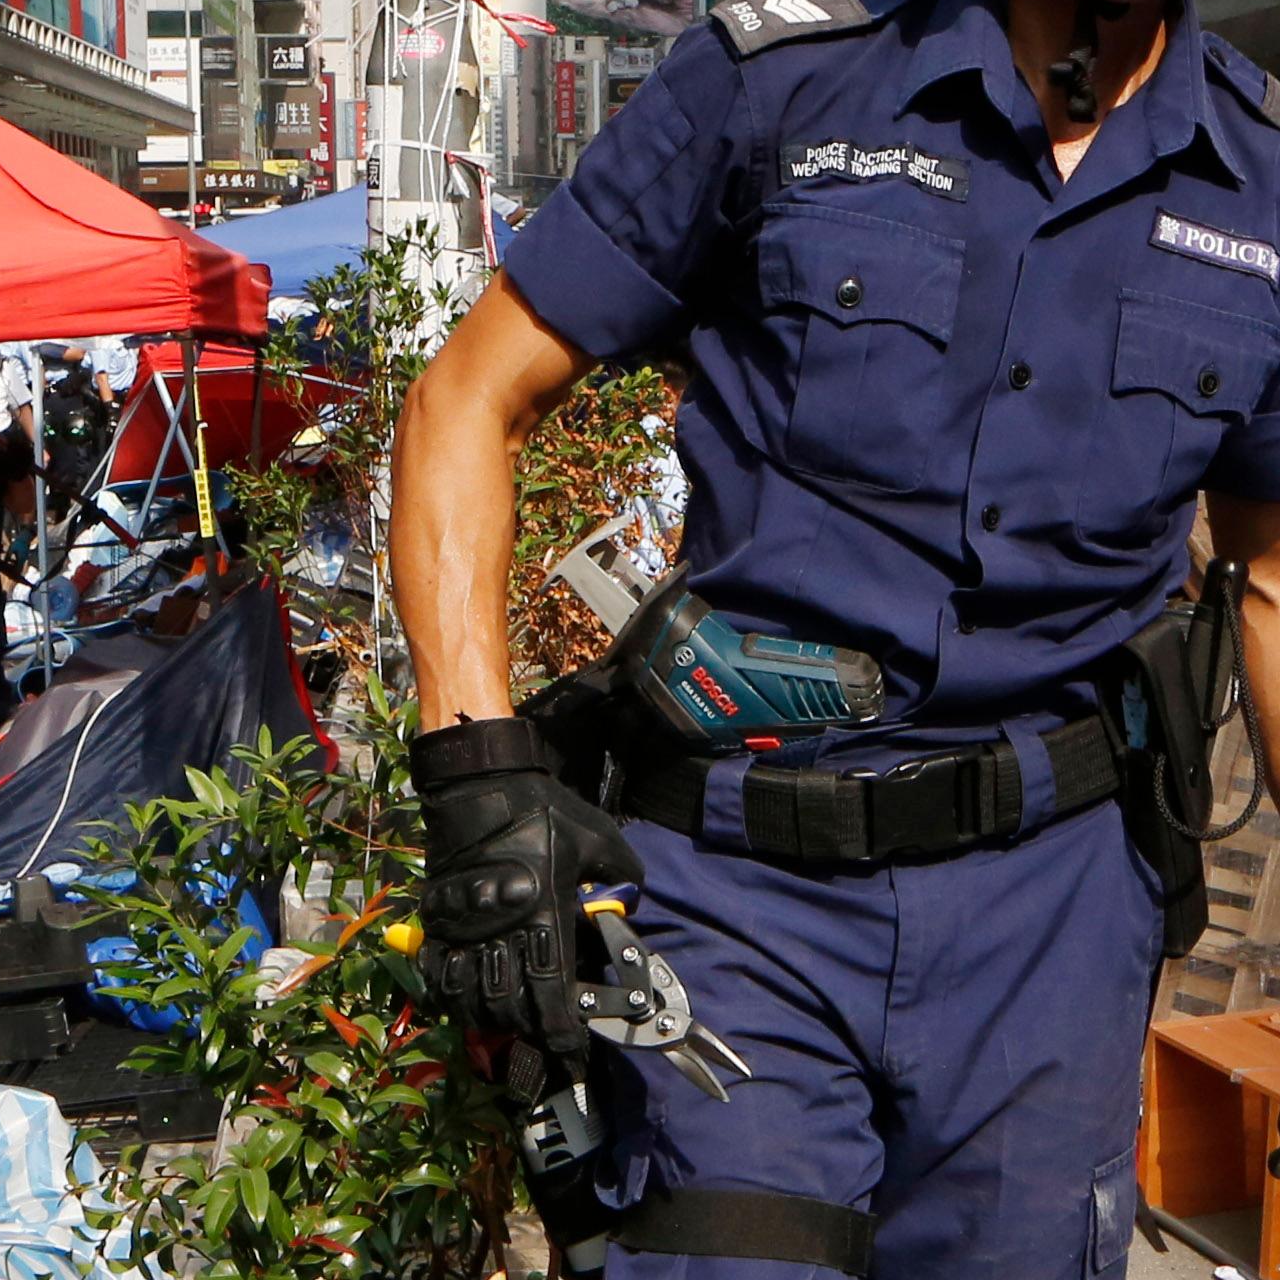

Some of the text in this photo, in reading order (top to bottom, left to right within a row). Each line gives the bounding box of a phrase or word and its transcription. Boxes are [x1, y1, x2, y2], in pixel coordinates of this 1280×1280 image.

[272, 47, 304, 63] 六福
[275, 102, 311, 126] 周生生
[806, 141, 940, 172] POLICE TACTICAL UNIT
[850, 160, 902, 178] TRAINING
[907, 162, 953, 192] SECTION
[1184, 225, 1270, 269] POLICE
[691, 666, 739, 716] BOSCH
